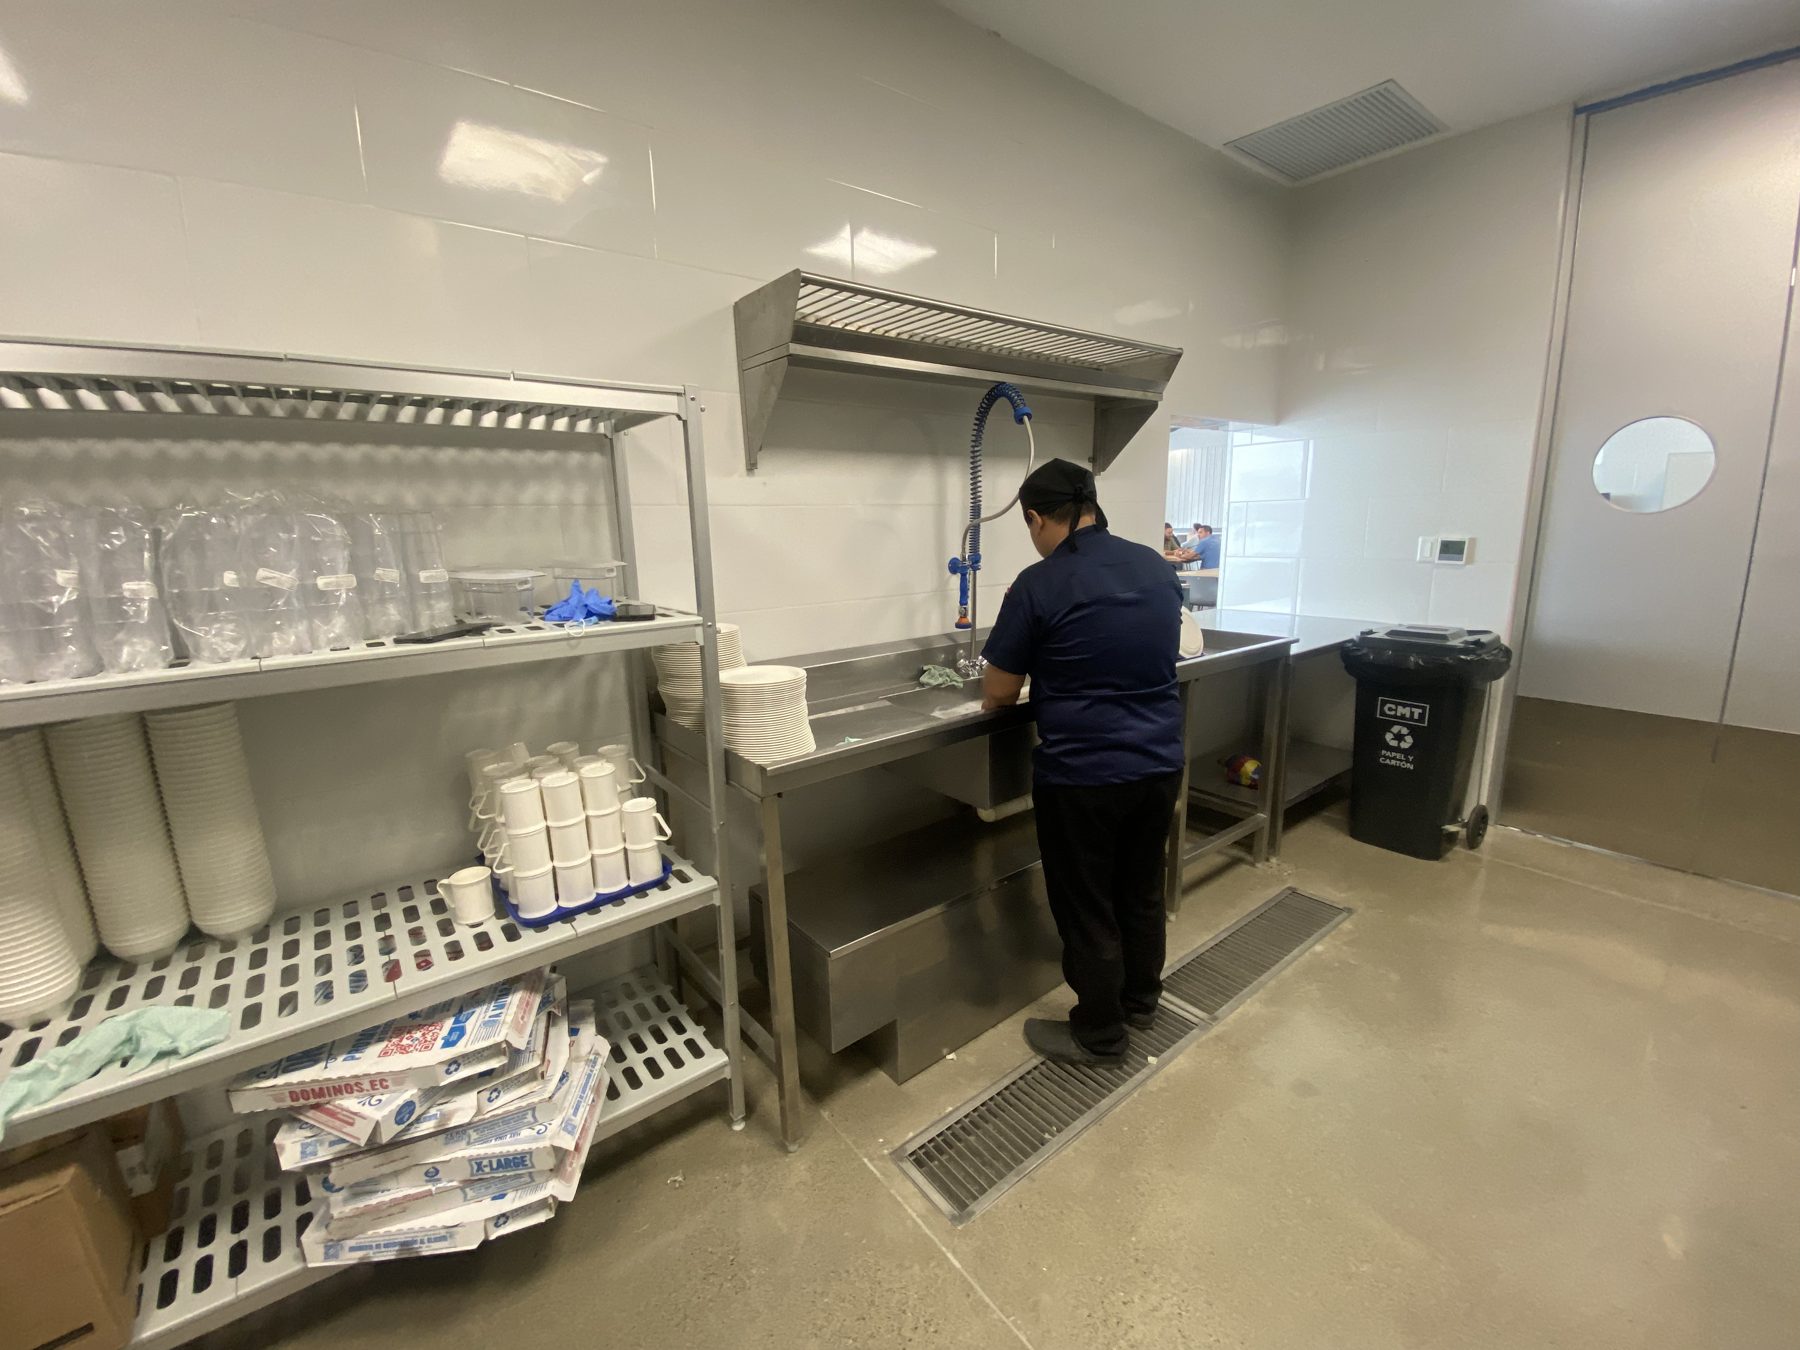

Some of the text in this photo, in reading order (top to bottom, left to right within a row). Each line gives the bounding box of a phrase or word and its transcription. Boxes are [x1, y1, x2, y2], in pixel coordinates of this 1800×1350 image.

[1383, 703, 1423, 720] CMT
[1381, 749, 1414, 762] PAPEL Y
[288, 1078, 390, 1103] DOMINOS.EC
[474, 1155, 529, 1173] X-LARGE
